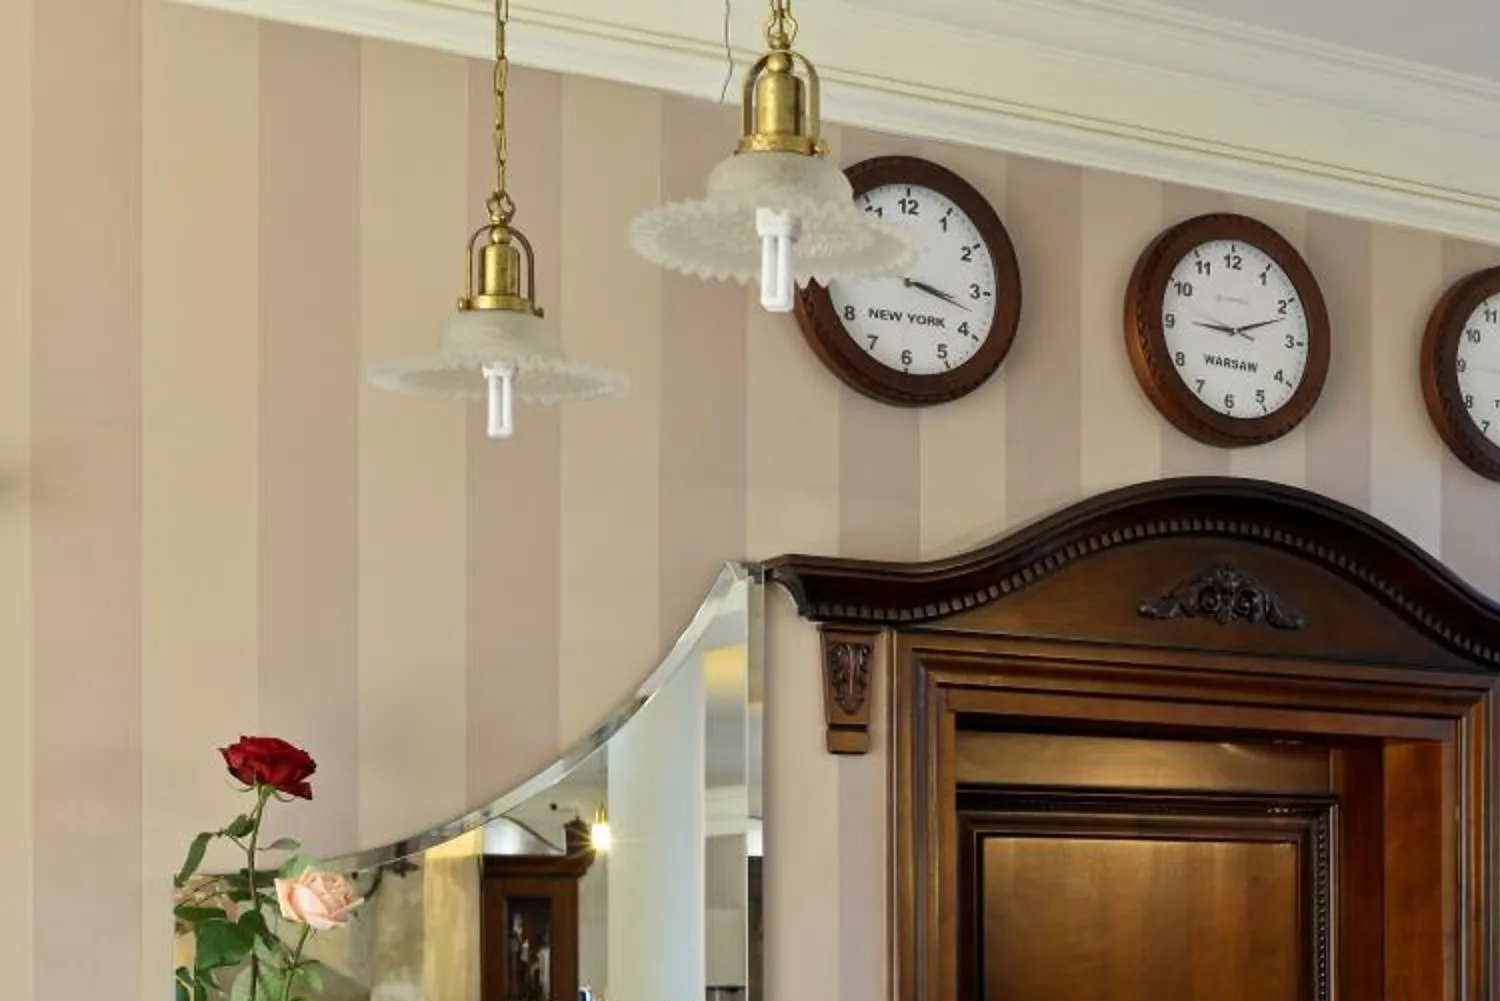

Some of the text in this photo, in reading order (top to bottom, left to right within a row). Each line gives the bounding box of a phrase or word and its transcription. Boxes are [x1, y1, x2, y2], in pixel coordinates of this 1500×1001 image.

[898, 198, 919, 216] 12
[939, 216, 948, 232] 1
[960, 246, 973, 262] 2
[1195, 261, 1211, 276] 11
[1223, 255, 1243, 271] 12
[1259, 271, 1267, 285] 1
[969, 284, 981, 299] 3
[1174, 281, 1193, 297] 10
[843, 305, 856, 321] 8
[1277, 300, 1287, 314] 2
[868, 307, 945, 328] NEW YORK
[1165, 313, 1175, 328] 9
[1483, 309, 1497, 324] 11
[957, 321, 969, 336] 4
[1466, 328, 1481, 344] 10
[867, 335, 878, 350] 7
[1285, 335, 1294, 349] 3
[900, 349, 912, 365] 6
[937, 344, 948, 359] 5
[1175, 351, 1185, 366] 8
[1204, 354, 1258, 373] WARSAW
[1457, 359, 1466, 373] 9
[1273, 369, 1283, 383] 4
[1195, 379, 1205, 393] 7
[1224, 394, 1234, 408] 6
[1256, 389, 1265, 403] 5
[1465, 395, 1473, 409] 8
[1481, 421, 1490, 433] 7
